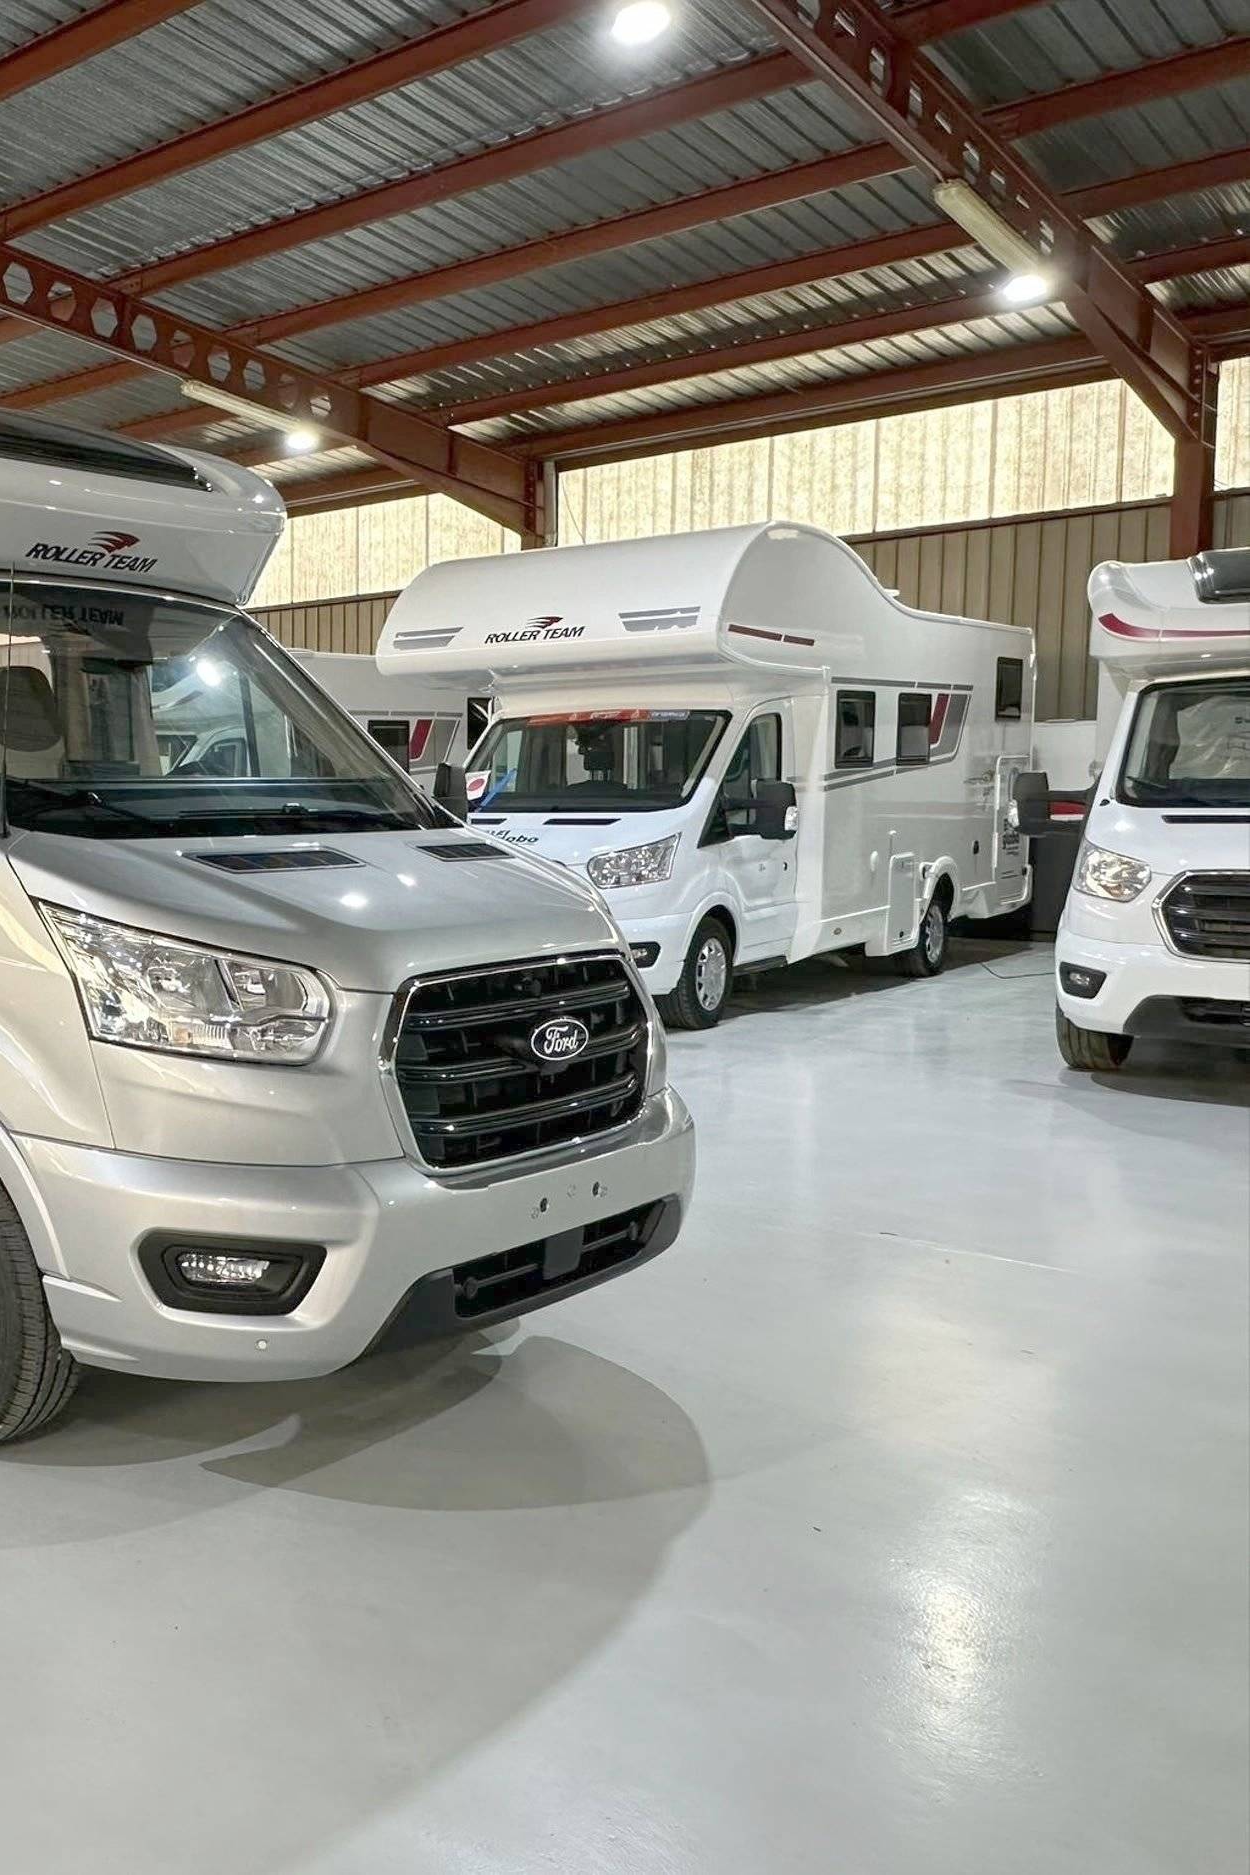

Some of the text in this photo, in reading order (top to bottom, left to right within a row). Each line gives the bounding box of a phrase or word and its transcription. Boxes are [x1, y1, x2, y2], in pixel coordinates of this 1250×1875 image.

[25, 543, 158, 573] ROLLER TEAM
[484, 625, 586, 644] ROLLER TEAM
[544, 1025, 579, 1054] Ford
